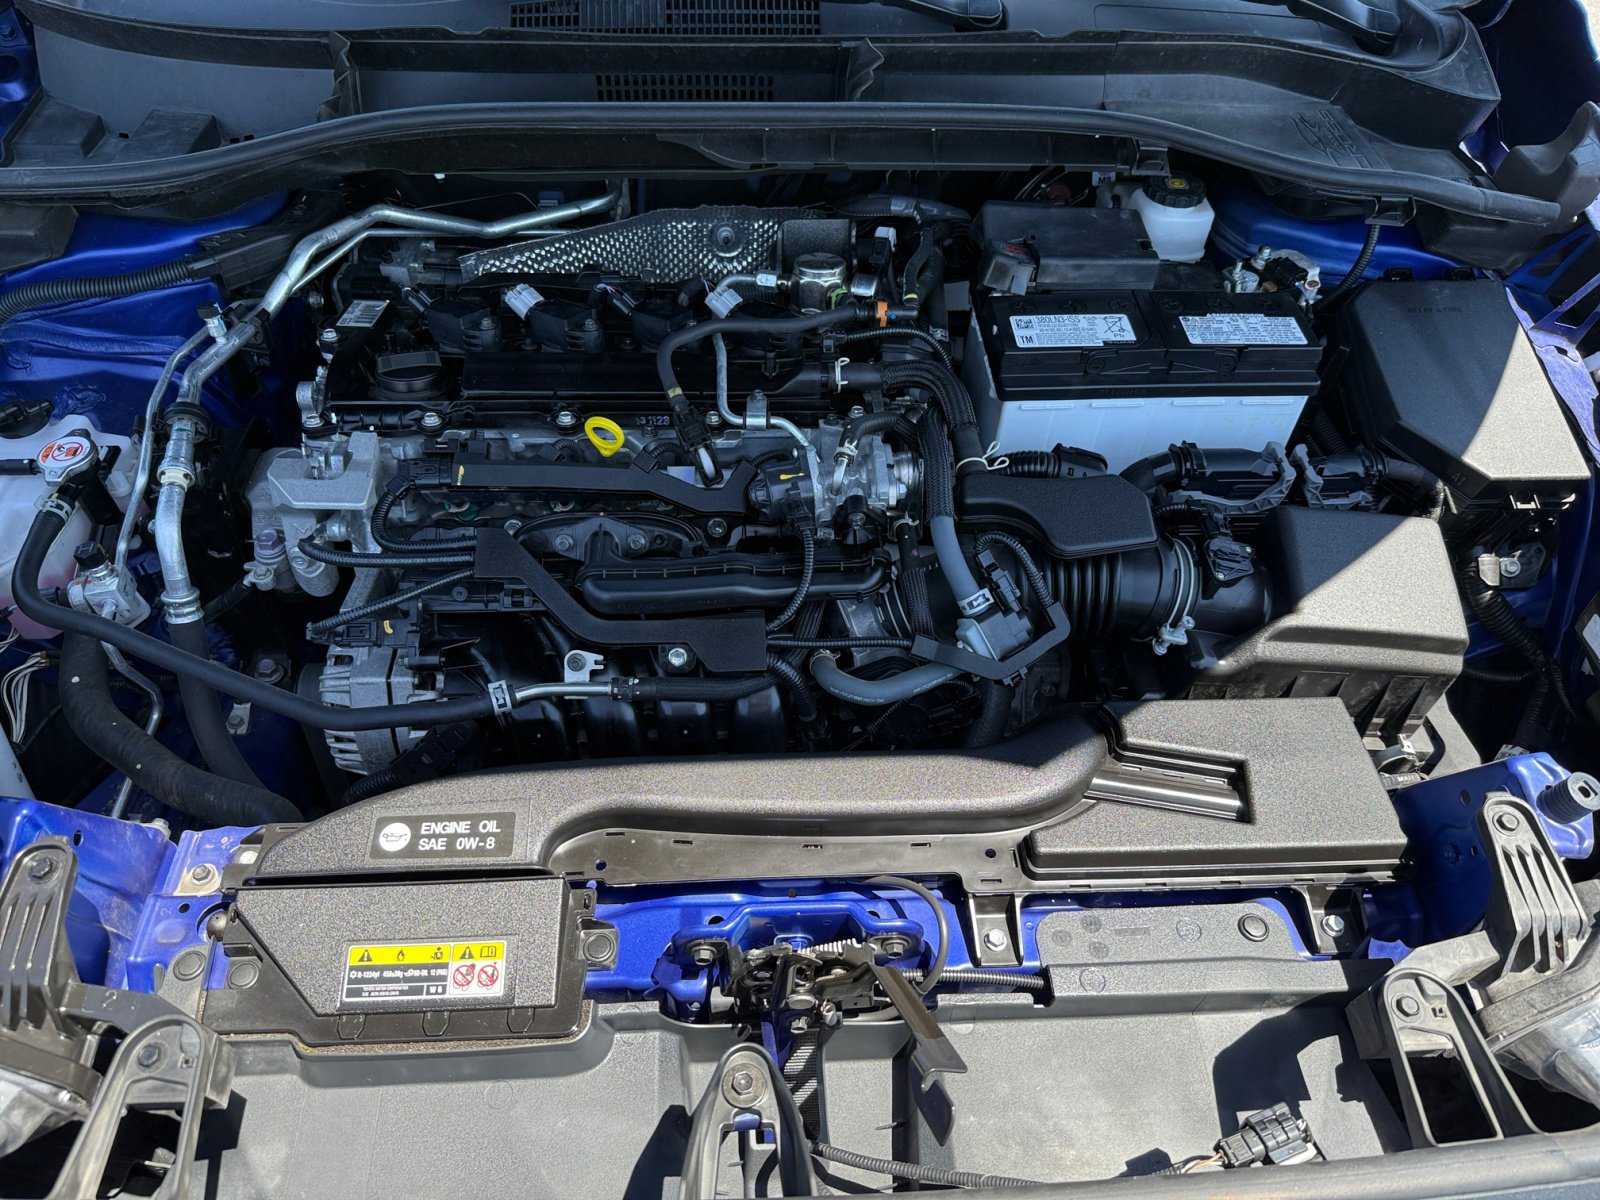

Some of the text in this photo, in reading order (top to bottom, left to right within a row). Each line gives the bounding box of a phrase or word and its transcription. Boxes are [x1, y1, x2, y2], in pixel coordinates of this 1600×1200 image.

[1019, 335, 1034, 344] TM
[420, 820, 501, 835] ENGINE OIL
[418, 836, 496, 851] SAE 0W-8
